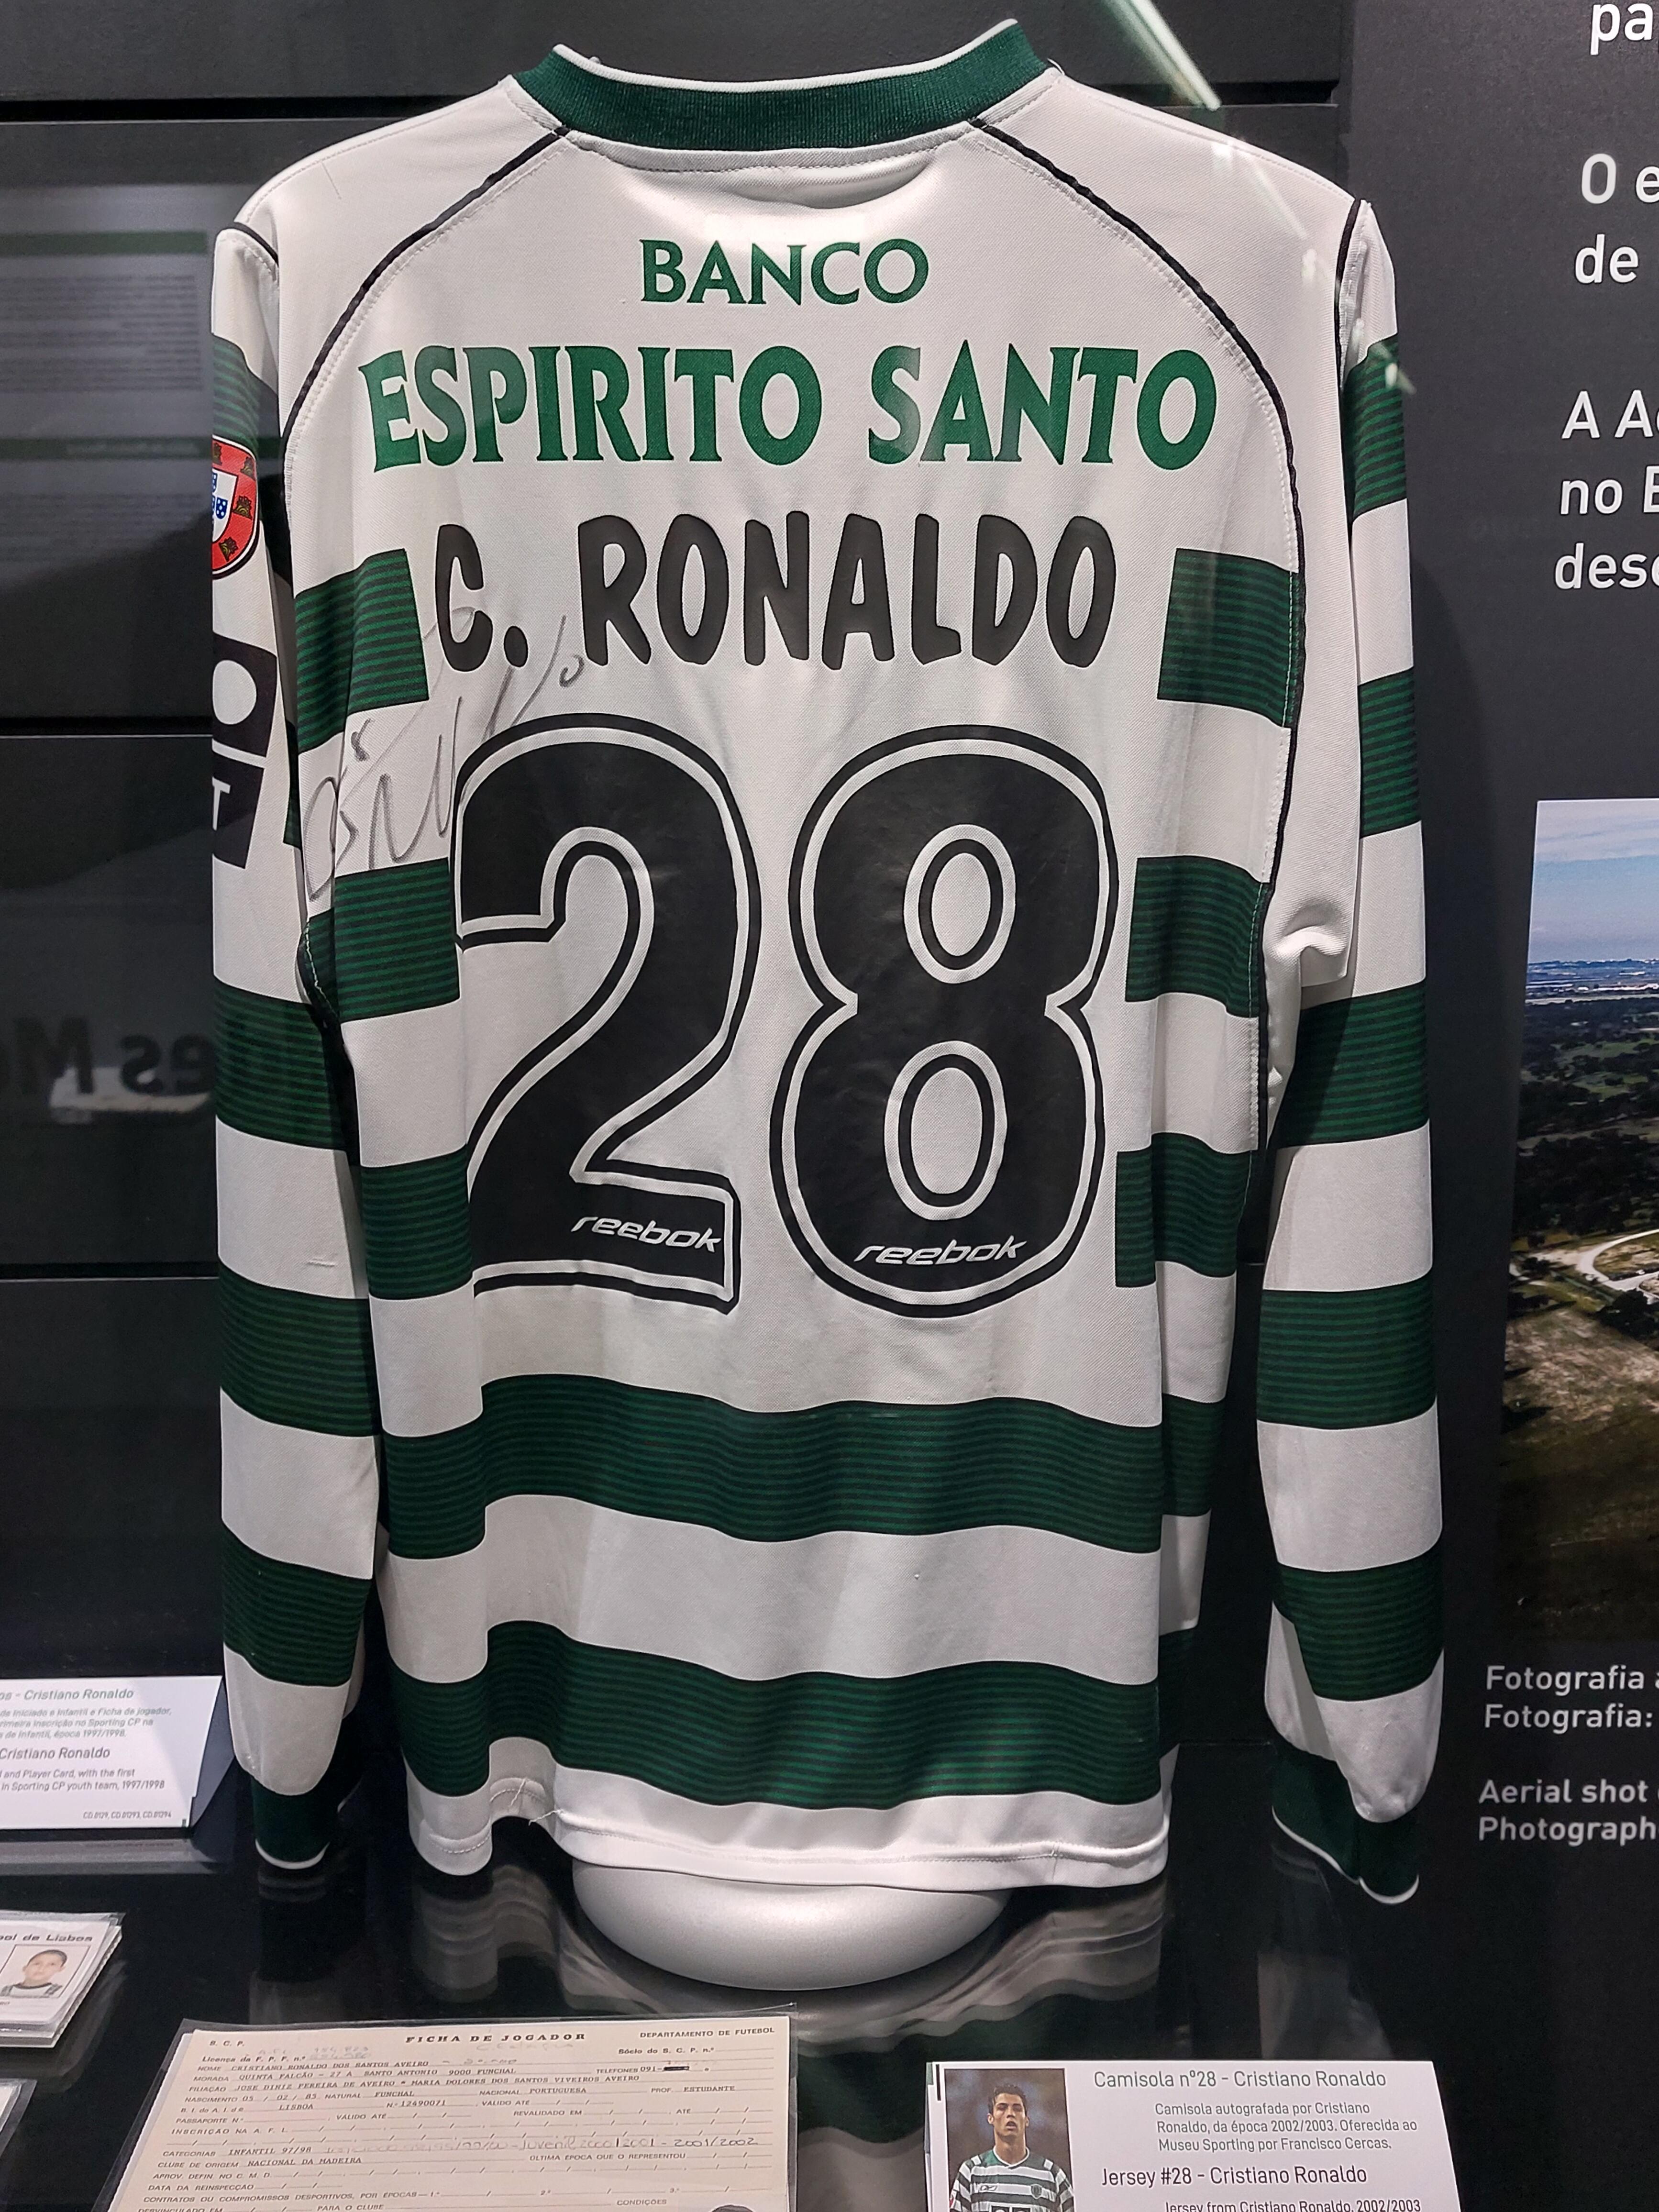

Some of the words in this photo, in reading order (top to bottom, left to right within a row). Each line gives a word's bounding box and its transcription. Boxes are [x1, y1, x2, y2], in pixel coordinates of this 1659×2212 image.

[1580, 153, 1617, 205] O
[640, 238, 930, 306] BANCO
[1574, 233, 1639, 284] de
[358, 344, 823, 474] ESPIRITO
[867, 339, 1218, 471] SANTO
[1561, 390, 1600, 439] A
[1614, 389, 1659, 438] A
[1560, 478, 1623, 515] no
[434, 524, 528, 672] C.
[577, 510, 1117, 671] RONALDO
[450, 712, 1120, 1319] 28
[571, 1215, 721, 1253] reebok
[853, 1235, 1028, 1265] reebok
[1486, 1665, 1644, 1696] Fotografia
[24, 1690, 79, 1700] Cristiano
[83, 1689, 133, 1699] Ronaldo
[127, 1718, 141, 1726] CP
[1484, 1703, 1653, 1734] Fotografia:
[0, 1748, 55, 1759] Cristiano
[58, 1747, 110, 1759] Ronaldo
[4, 1770, 21, 1778] and
[22, 1770, 51, 1779] Player
[78, 1769, 98, 1778] with
[100, 1769, 114, 1777] the
[117, 1768, 135, 1777] first
[11, 1781, 50, 1792] Sporting
[52, 1781, 66, 1791] CP
[67, 1781, 92, 1792] youth
[122, 1780, 165, 1790] 1997/1998
[1479, 1779, 1572, 1803] Aerial
[1582, 1779, 1648, 1803] shot
[1479, 1816, 1659, 1847] Photograph
[1095, 2071, 1174, 2087] Camisola
[1234, 2071, 1311, 2087] Cristiano
[1316, 2070, 1386, 2087] Ronaldo
[1155, 2103, 1212, 2115] Camisola
[1216, 2102, 1289, 2116] autografada
[1293, 2104, 1312, 2116] por
[1315, 2102, 1370, 2114] Cristiano
[1157, 2121, 1210, 2134] Ronaldo,
[1213, 2121, 1228, 2133] da
[1231, 2121, 1268, 2134] época
[1271, 2120, 1338, 2132] 2002/2003.
[1340, 2119, 1399, 2131] Oferecida
[1403, 2121, 1417, 2131] ao
[674, 2136, 758, 2146] 2001/2002
[1159, 2139, 1199, 2151] Museu
[1203, 2138, 1254, 2153] Sporting
[1258, 2140, 1277, 2152] por
[1281, 2137, 1341, 2150] Francisco
[1345, 2137, 1392, 2149] Cercas.
[1102, 2168, 1156, 2188] Jersey
[1161, 2167, 1192, 2185] #28
[1210, 2167, 1289, 2184] Cristiano
[1294, 2165, 1367, 2183] Ronaldo
[1164, 2202, 1203, 2212] Jersey
[1207, 2202, 1236, 2212] from
[1240, 2201, 1295, 2212] Cristiano
[1356, 2200, 1421, 2212] 2002/2003
